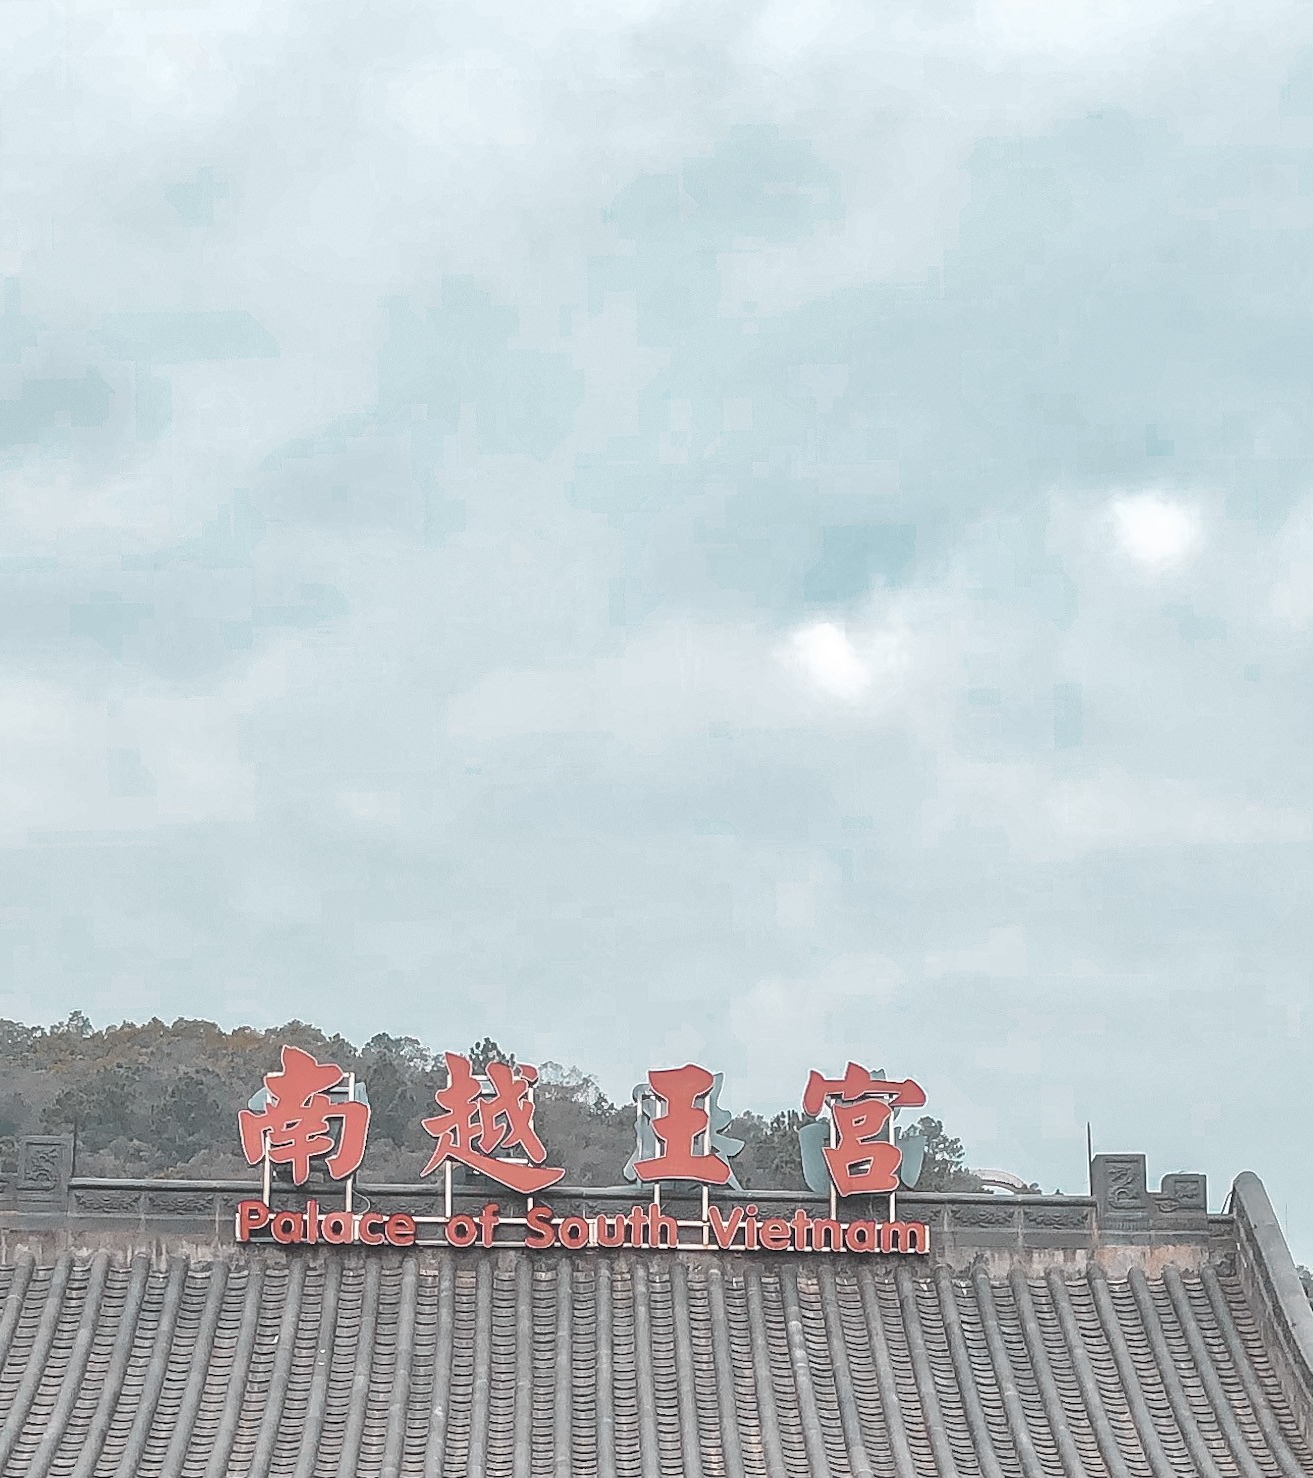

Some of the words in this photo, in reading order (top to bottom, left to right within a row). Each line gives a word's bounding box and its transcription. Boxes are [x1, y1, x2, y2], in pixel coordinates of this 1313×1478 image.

[238, 1045, 927, 1197] 南越王宫
[237, 1199, 417, 1246] Palace
[447, 1198, 498, 1248] of
[525, 1202, 679, 1250] South
[708, 1205, 927, 1254] Vietnam
